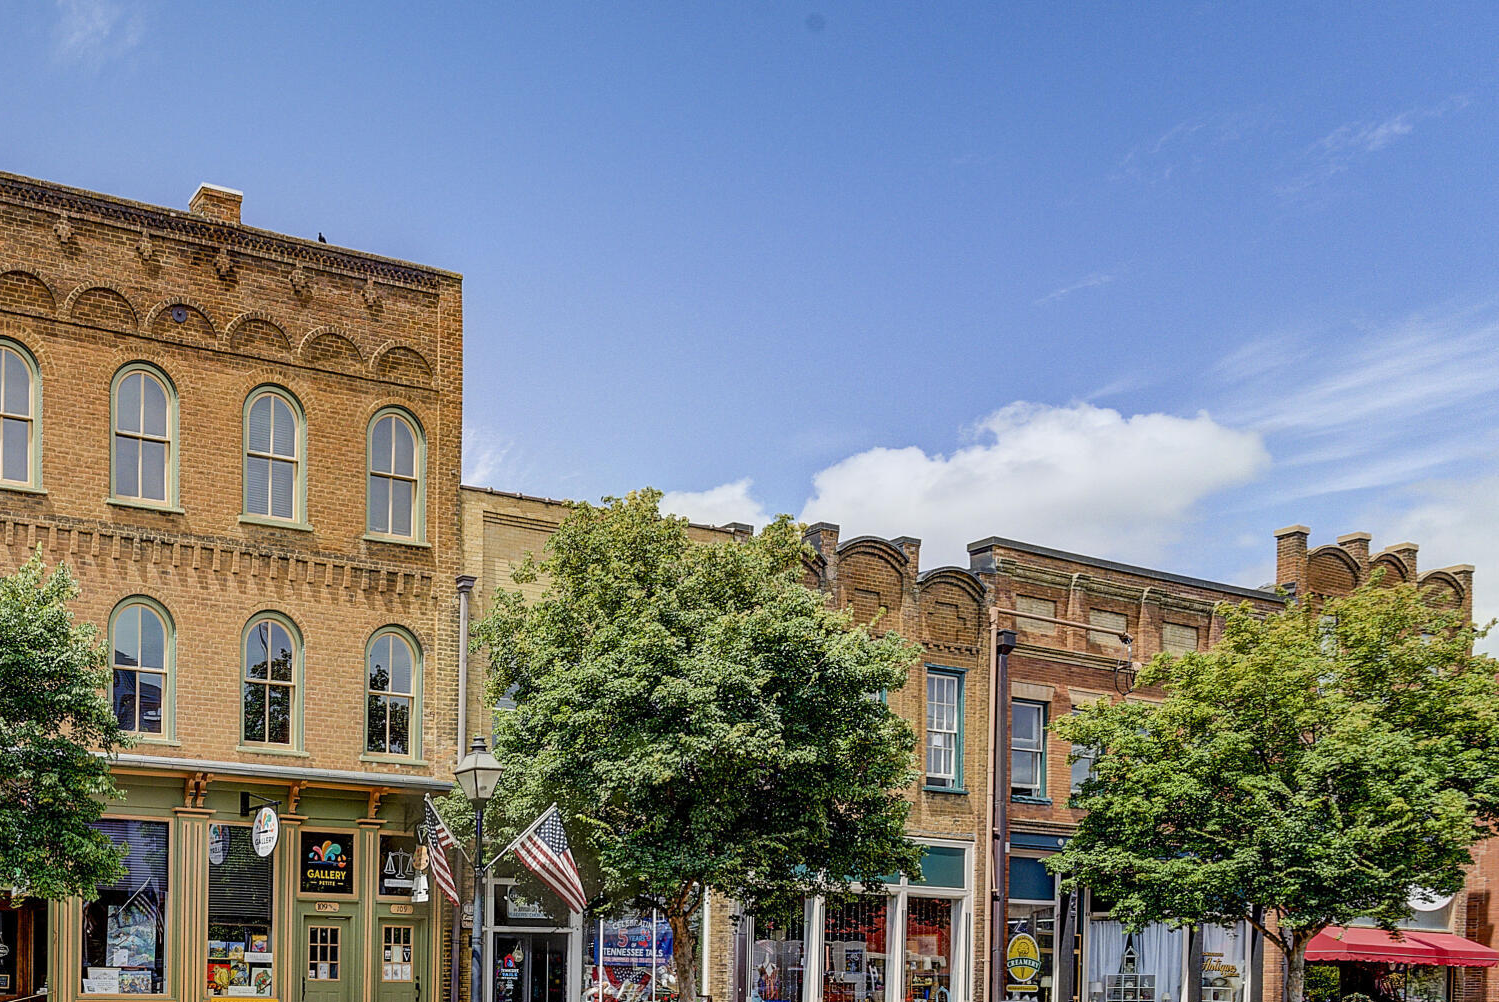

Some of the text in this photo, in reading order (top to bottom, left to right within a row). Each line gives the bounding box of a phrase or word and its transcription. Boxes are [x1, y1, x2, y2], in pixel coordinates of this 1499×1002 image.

[255, 836, 274, 846] GALLERY
[307, 869, 347, 880] GALLERY
[317, 903, 328, 911] 109
[612, 919, 655, 930] CELEBRATIN
[617, 928, 629, 948] 5
[603, 948, 664, 957] TENNESSEE TALS
[1007, 959, 1041, 969] CREAMERY
[1202, 958, 1237, 975] Antiques
